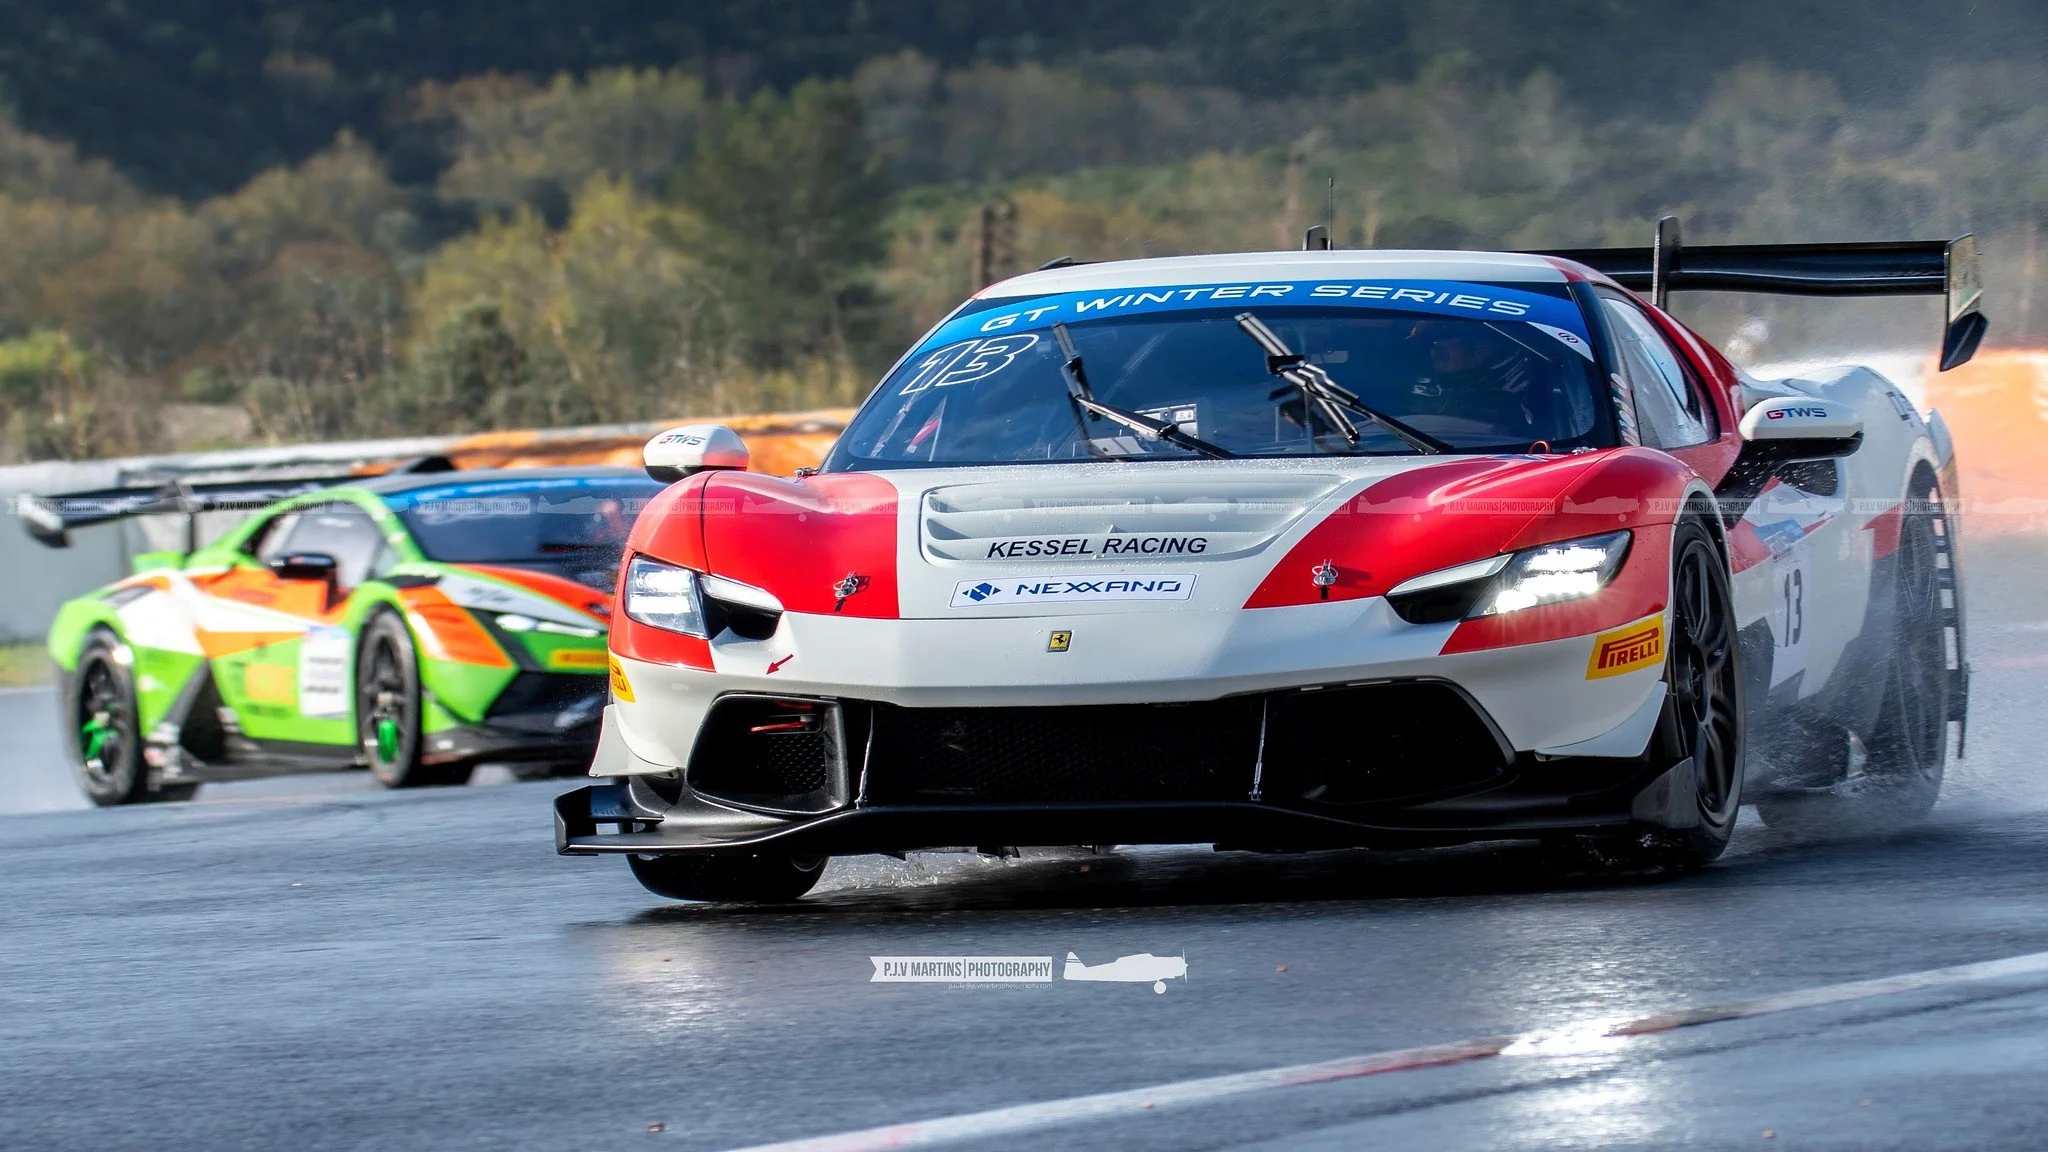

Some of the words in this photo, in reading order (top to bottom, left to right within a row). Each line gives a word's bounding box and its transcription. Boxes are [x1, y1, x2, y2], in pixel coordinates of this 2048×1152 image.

[982, 305, 1058, 332] GT
[1076, 285, 1295, 311] WINTER
[1310, 285, 1531, 316] SERIES
[900, 334, 1040, 394] 13
[1766, 407, 1828, 420] GTWS
[659, 434, 706, 446] GTWS
[987, 539, 1094, 558] KESSEL
[1101, 537, 1209, 555] RACING
[1016, 580, 1182, 595] NEXXANO
[1784, 568, 1803, 647] 13
[1597, 627, 1660, 669] PIRELLI
